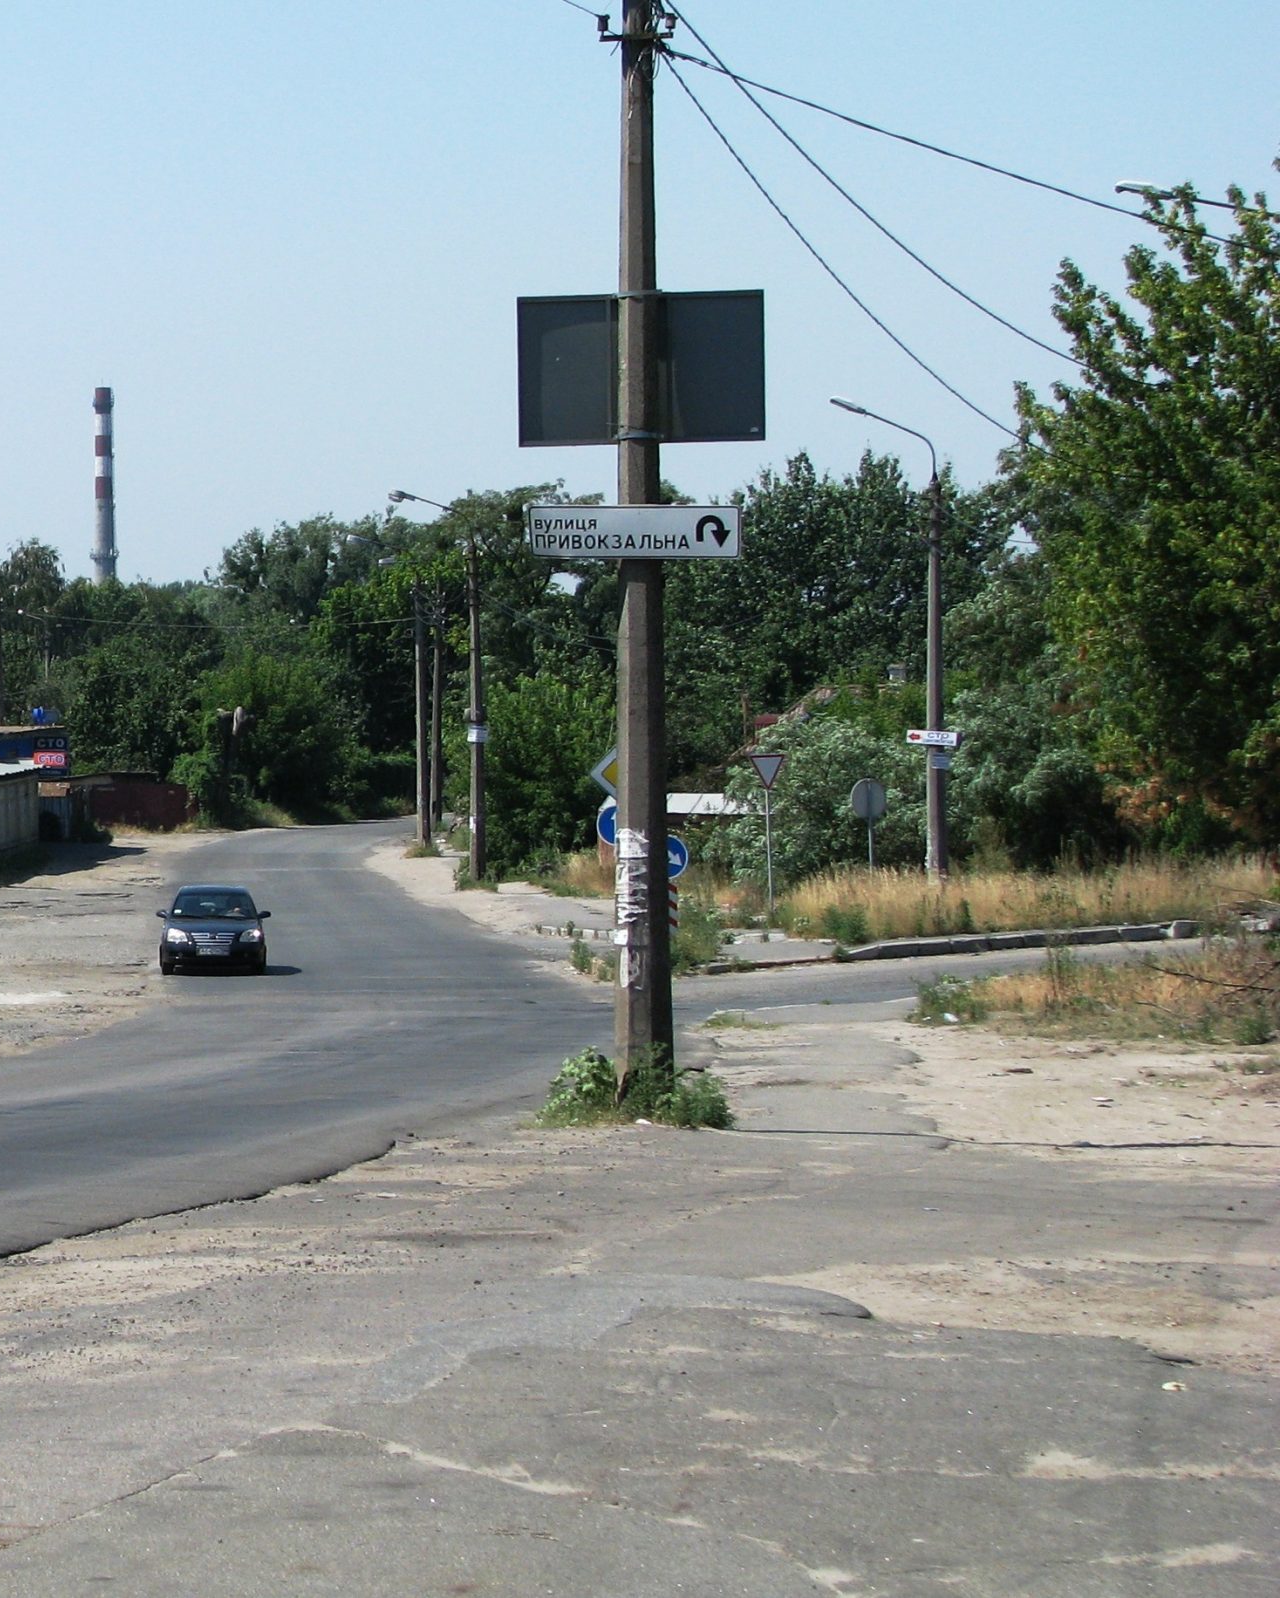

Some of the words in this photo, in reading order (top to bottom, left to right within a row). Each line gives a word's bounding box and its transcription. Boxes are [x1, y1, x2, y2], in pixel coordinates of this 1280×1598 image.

[535, 518, 597, 534] вулиця
[534, 534, 690, 550] ПРИВОКЗАЛЬНА
[37, 738, 65, 748] СТО
[38, 753, 65, 764] СТО
